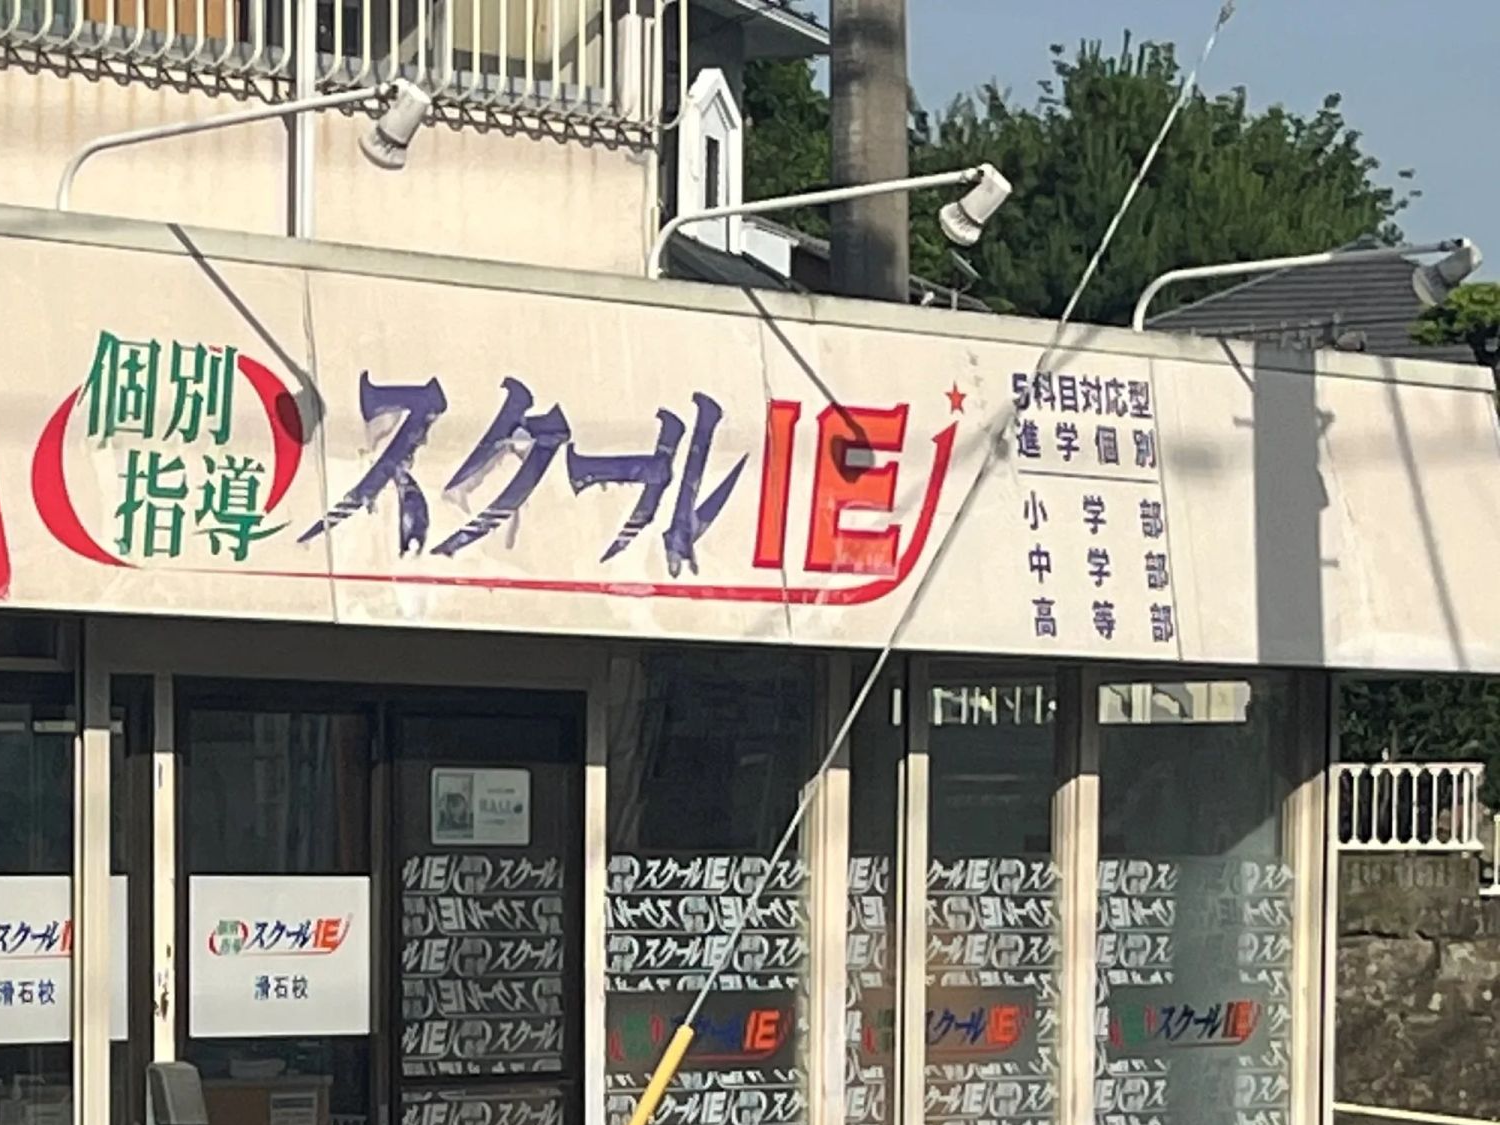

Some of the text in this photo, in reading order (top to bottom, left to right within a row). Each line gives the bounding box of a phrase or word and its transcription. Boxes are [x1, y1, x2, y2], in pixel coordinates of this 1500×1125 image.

[77, 330, 238, 446] 個別
[1015, 417, 1157, 468] 進学個別
[114, 449, 292, 561] 指導
[297, 370, 908, 578] スクールIE
